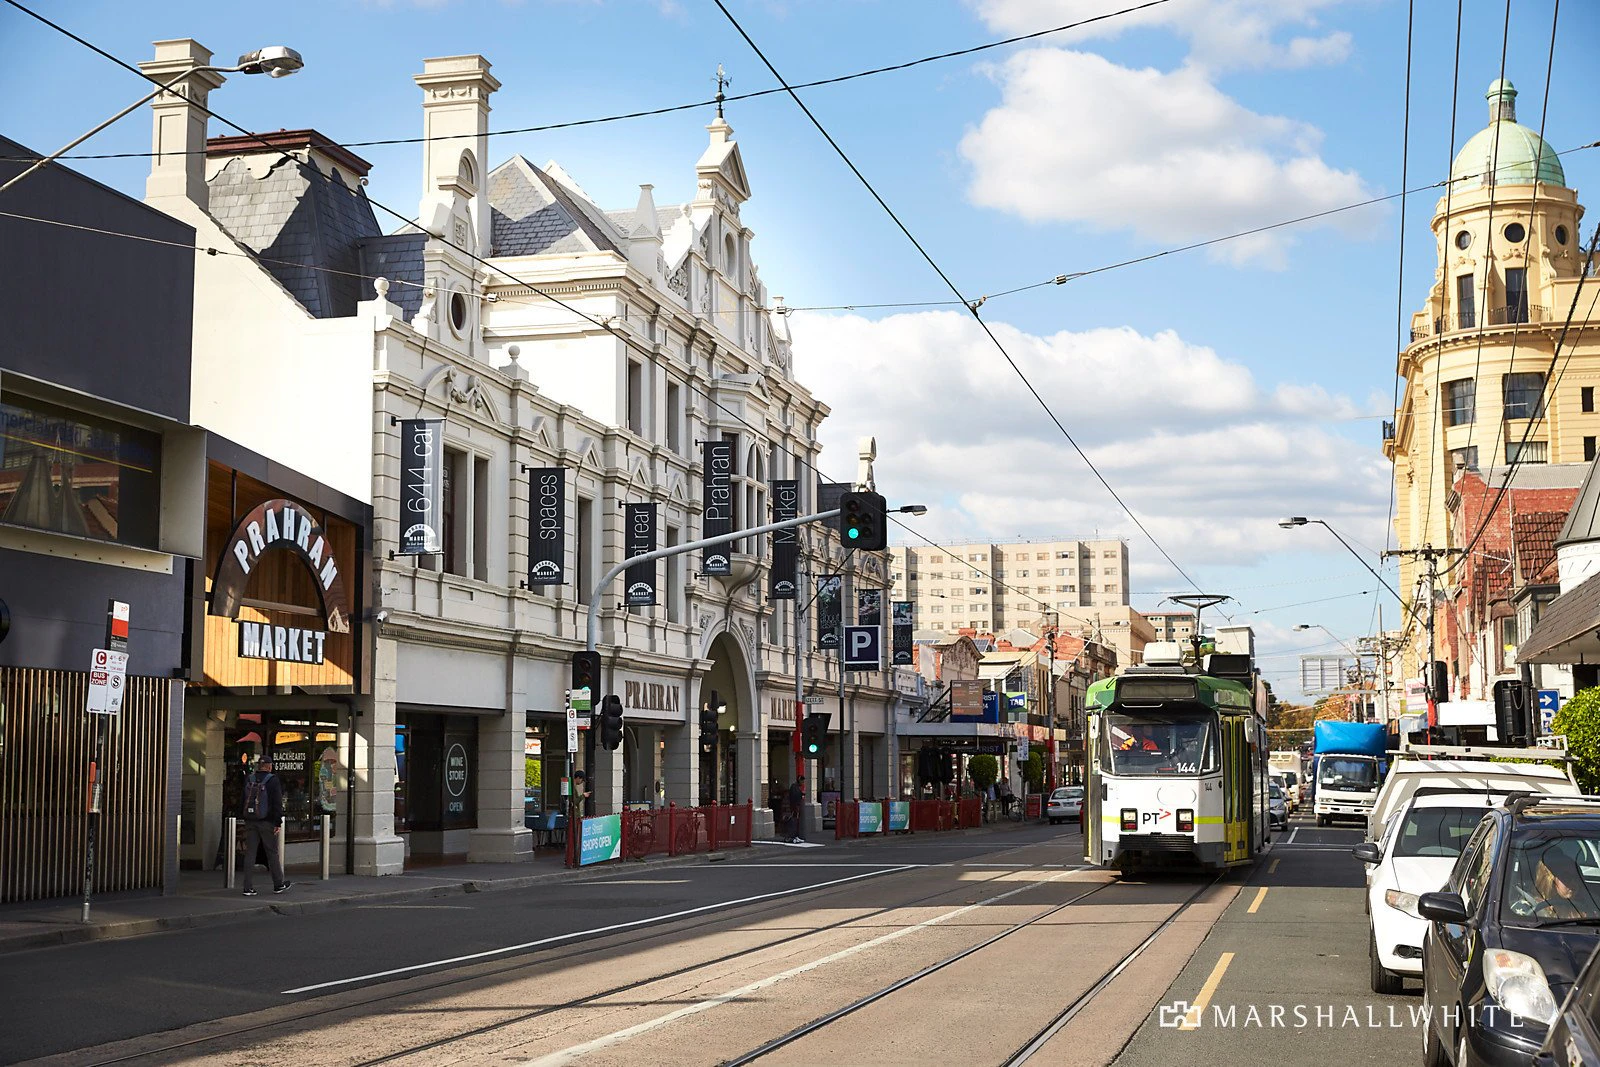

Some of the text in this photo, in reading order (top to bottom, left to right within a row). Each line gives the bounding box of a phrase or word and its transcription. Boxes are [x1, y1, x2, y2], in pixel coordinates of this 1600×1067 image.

[407, 425, 433, 513] 644 car
[706, 447, 730, 520] Prahran
[540, 475, 561, 540] spaces
[634, 508, 649, 538] rear
[234, 507, 338, 591] PRAHRAN
[243, 621, 325, 664] MARKET
[852, 631, 872, 658] P
[625, 680, 680, 713] PRAHRAN
[273, 752, 306, 761] BLACKHEARTS
[279, 762, 304, 771] SPARROWS
[450, 756, 463, 767] WINE
[1176, 762, 1196, 773] 144
[449, 770, 464, 780] STORE
[1204, 782, 1213, 791] 144
[449, 801, 463, 811] OPEN
[582, 835, 612, 852] SHOPS OPEN
